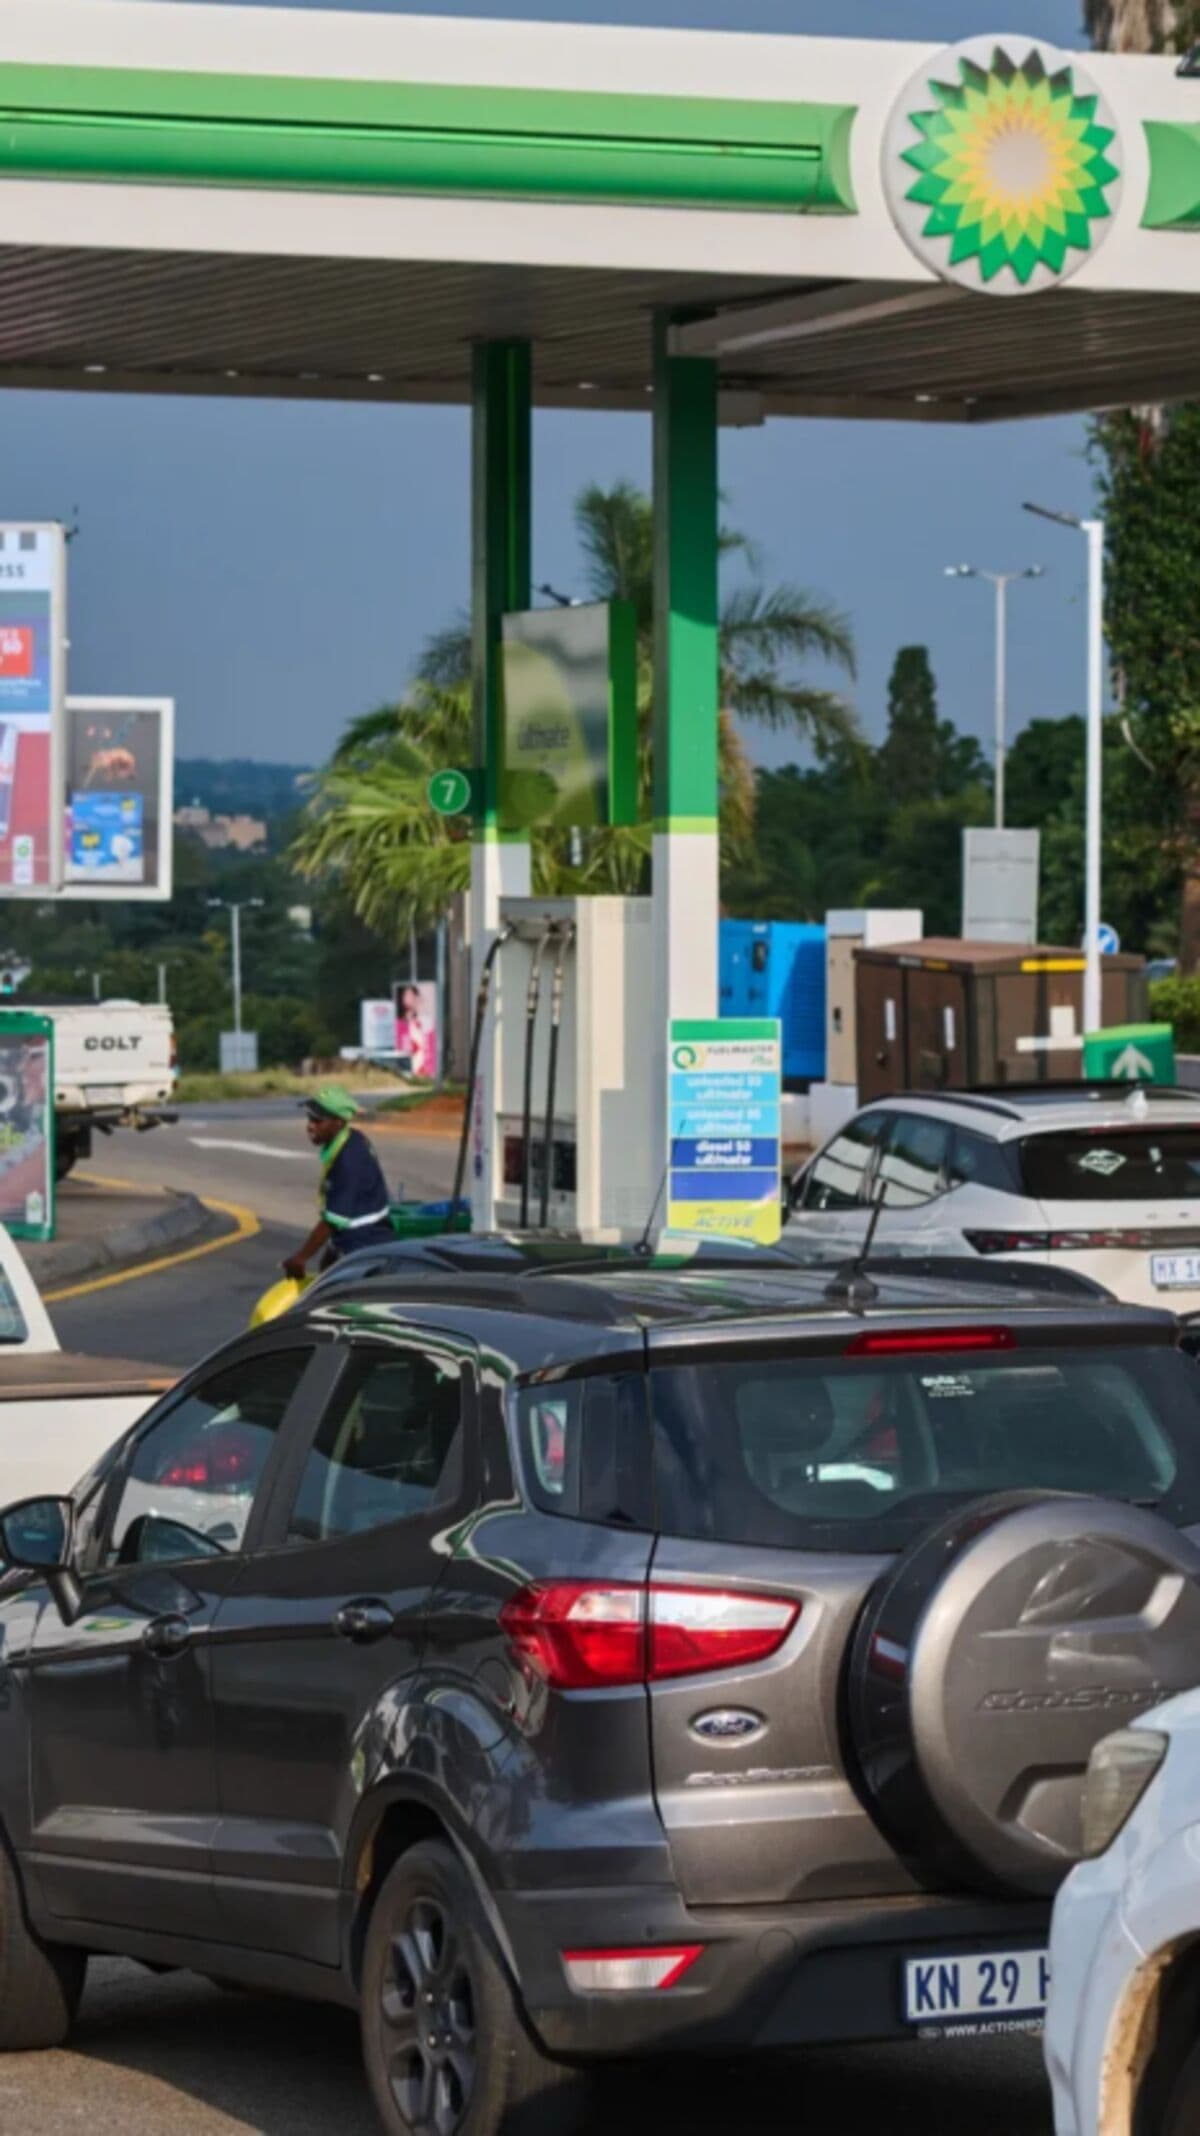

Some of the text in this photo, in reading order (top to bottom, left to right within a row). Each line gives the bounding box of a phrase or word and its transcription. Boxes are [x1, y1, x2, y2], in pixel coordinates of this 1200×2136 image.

[438, 780, 455, 804] 7
[84, 1035, 142, 1051] COLT
[696, 1140, 733, 1153] diesel
[695, 1152, 753, 1166] ultimate
[915, 1963, 959, 2012] KN
[978, 1960, 1020, 2007] 29
